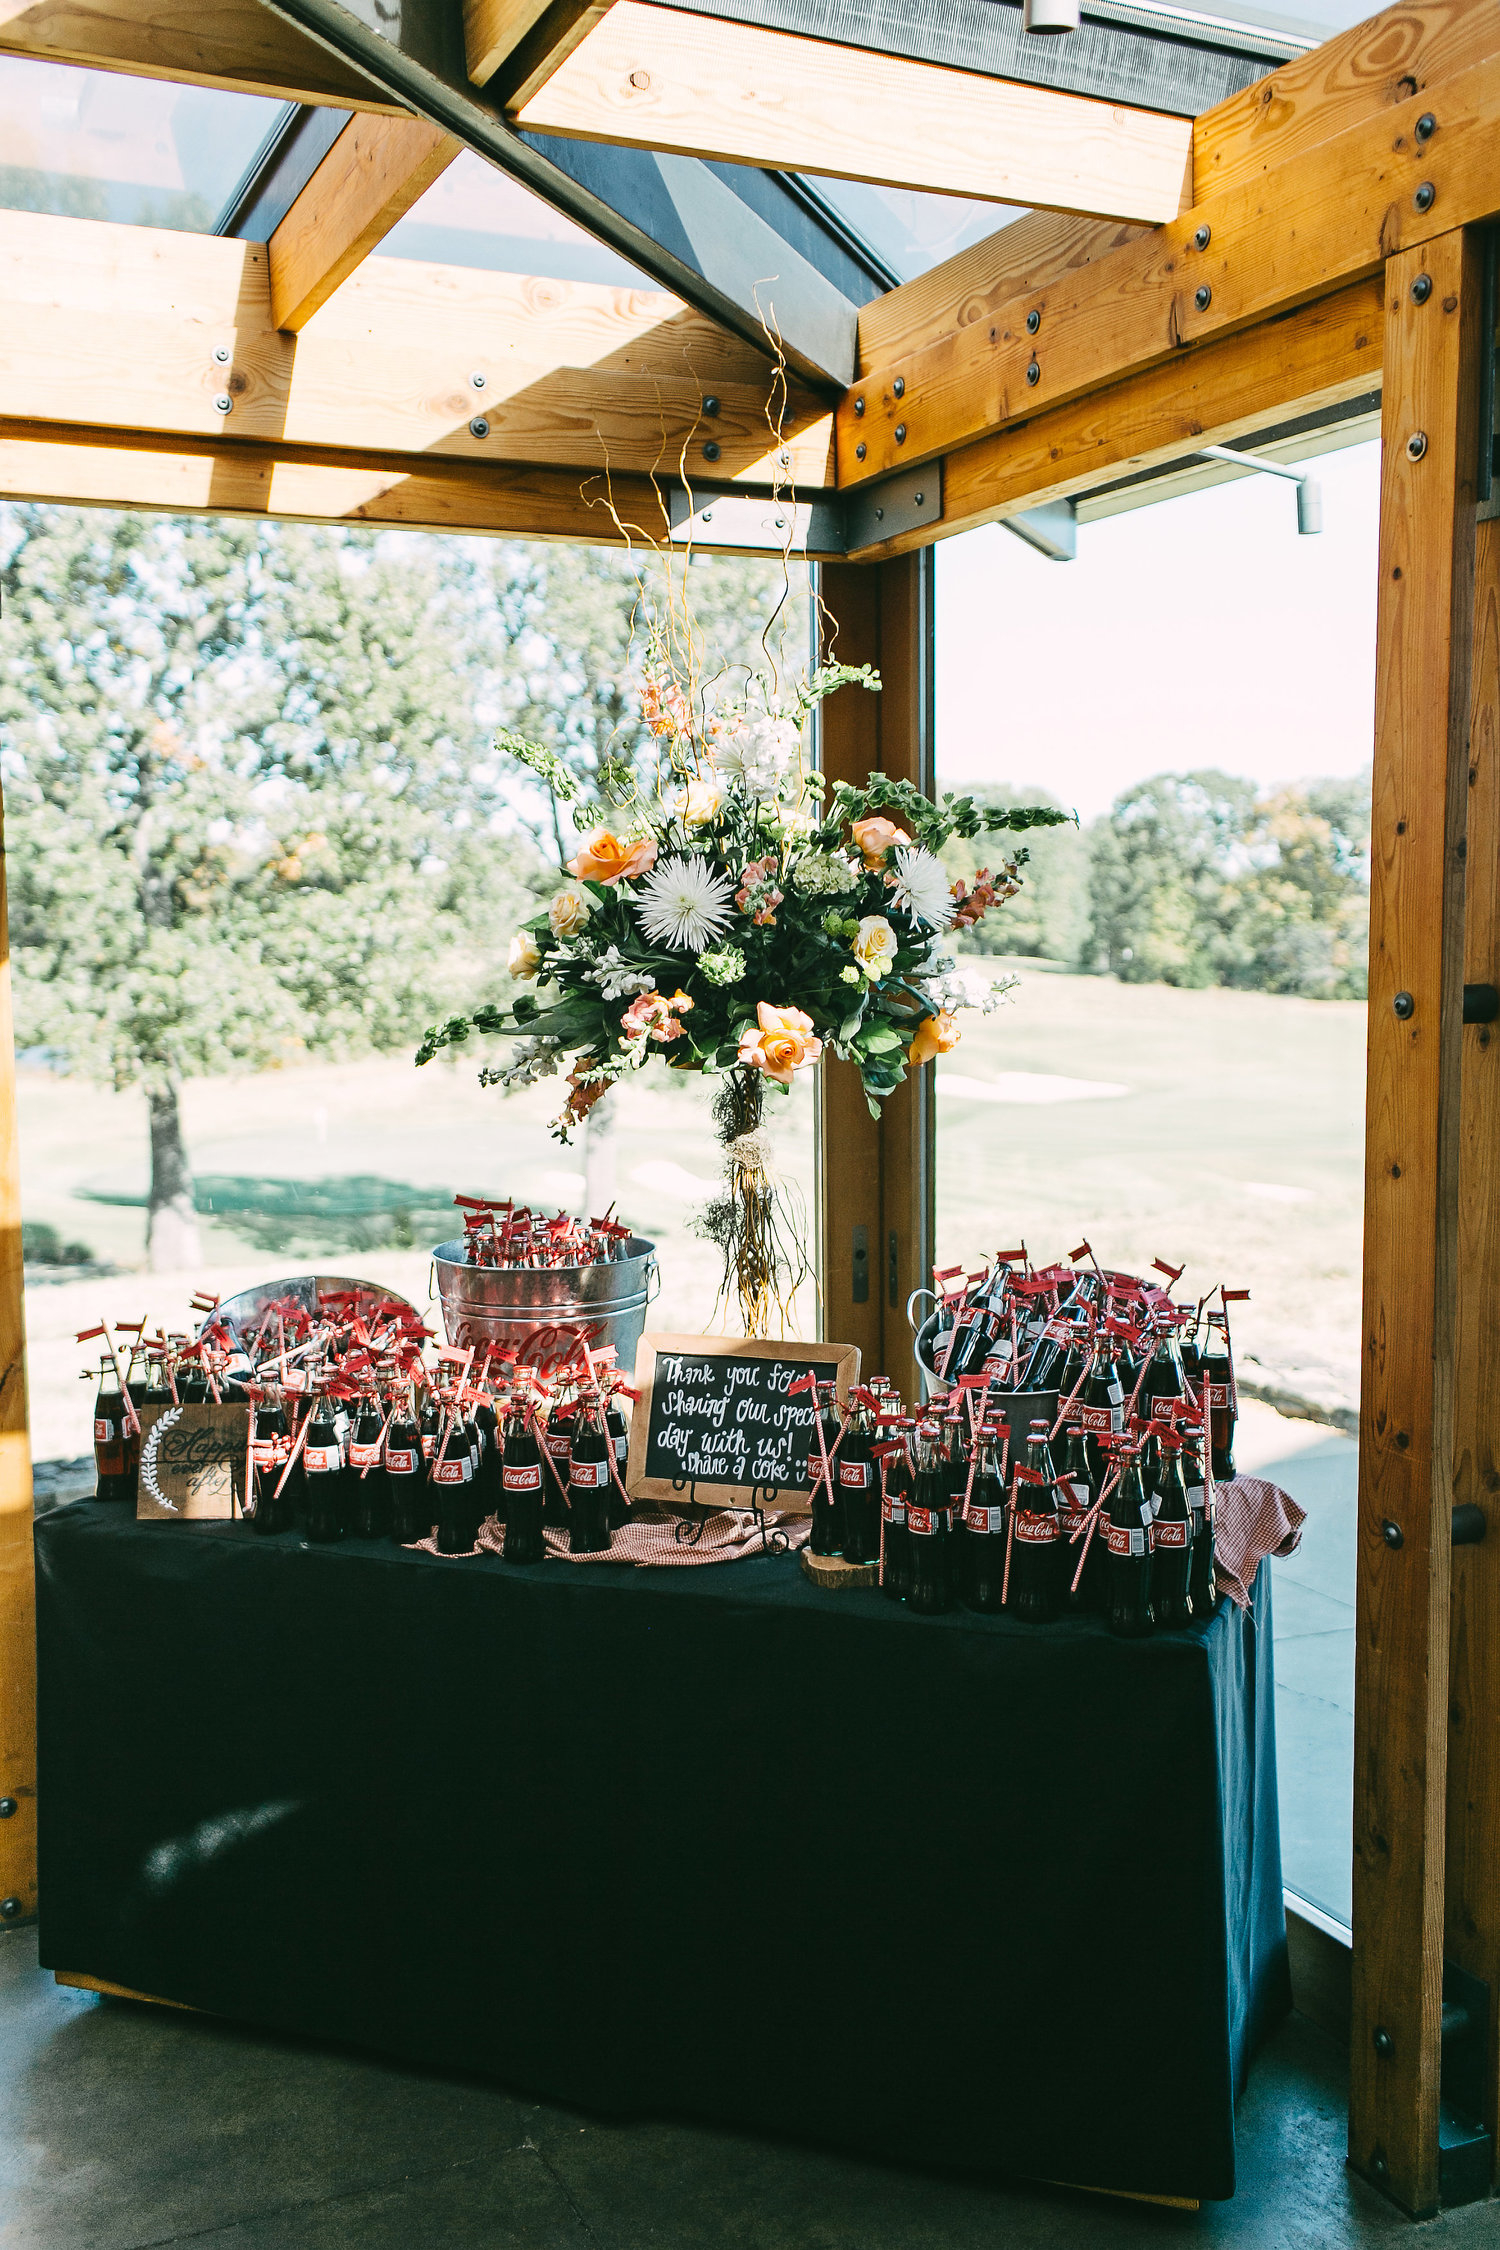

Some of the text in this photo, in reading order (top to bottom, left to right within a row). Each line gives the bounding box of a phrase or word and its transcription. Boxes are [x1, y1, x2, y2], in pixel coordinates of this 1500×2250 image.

[662, 1357, 715, 1386] Thank
[724, 1366, 760, 1396] you
[774, 1404, 816, 1431] speci
[657, 1422, 794, 1462] day with us!
[504, 1467, 538, 1485] Coca-Cola
[733, 1455, 747, 1480] a
